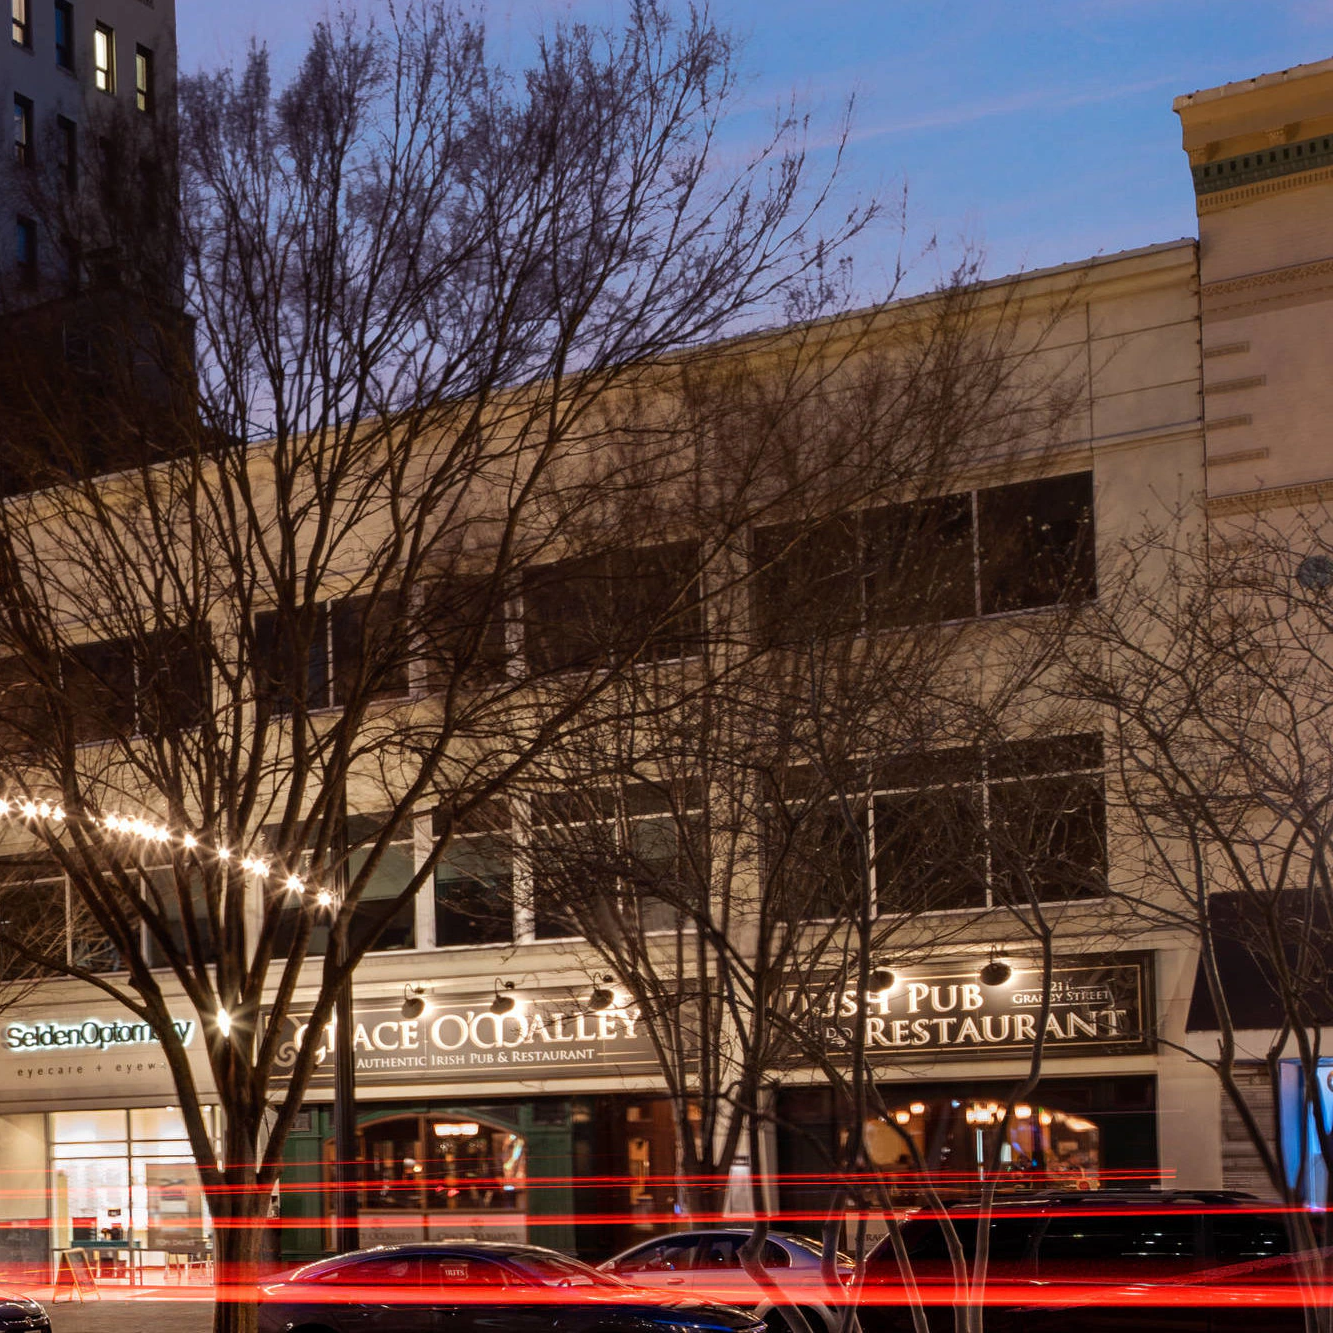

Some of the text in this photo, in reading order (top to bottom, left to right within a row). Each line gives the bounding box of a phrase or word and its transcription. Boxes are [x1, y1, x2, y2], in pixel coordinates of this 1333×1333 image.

[906, 983, 984, 1014] PUB
[1066, 990, 1109, 1001] STREET
[864, 1008, 1127, 1048] RESTAURANT
[356, 1049, 595, 1070] AUTHENTIC IRISH PUB & RESTAURANT
[17, 1066, 84, 1079] eyecare
